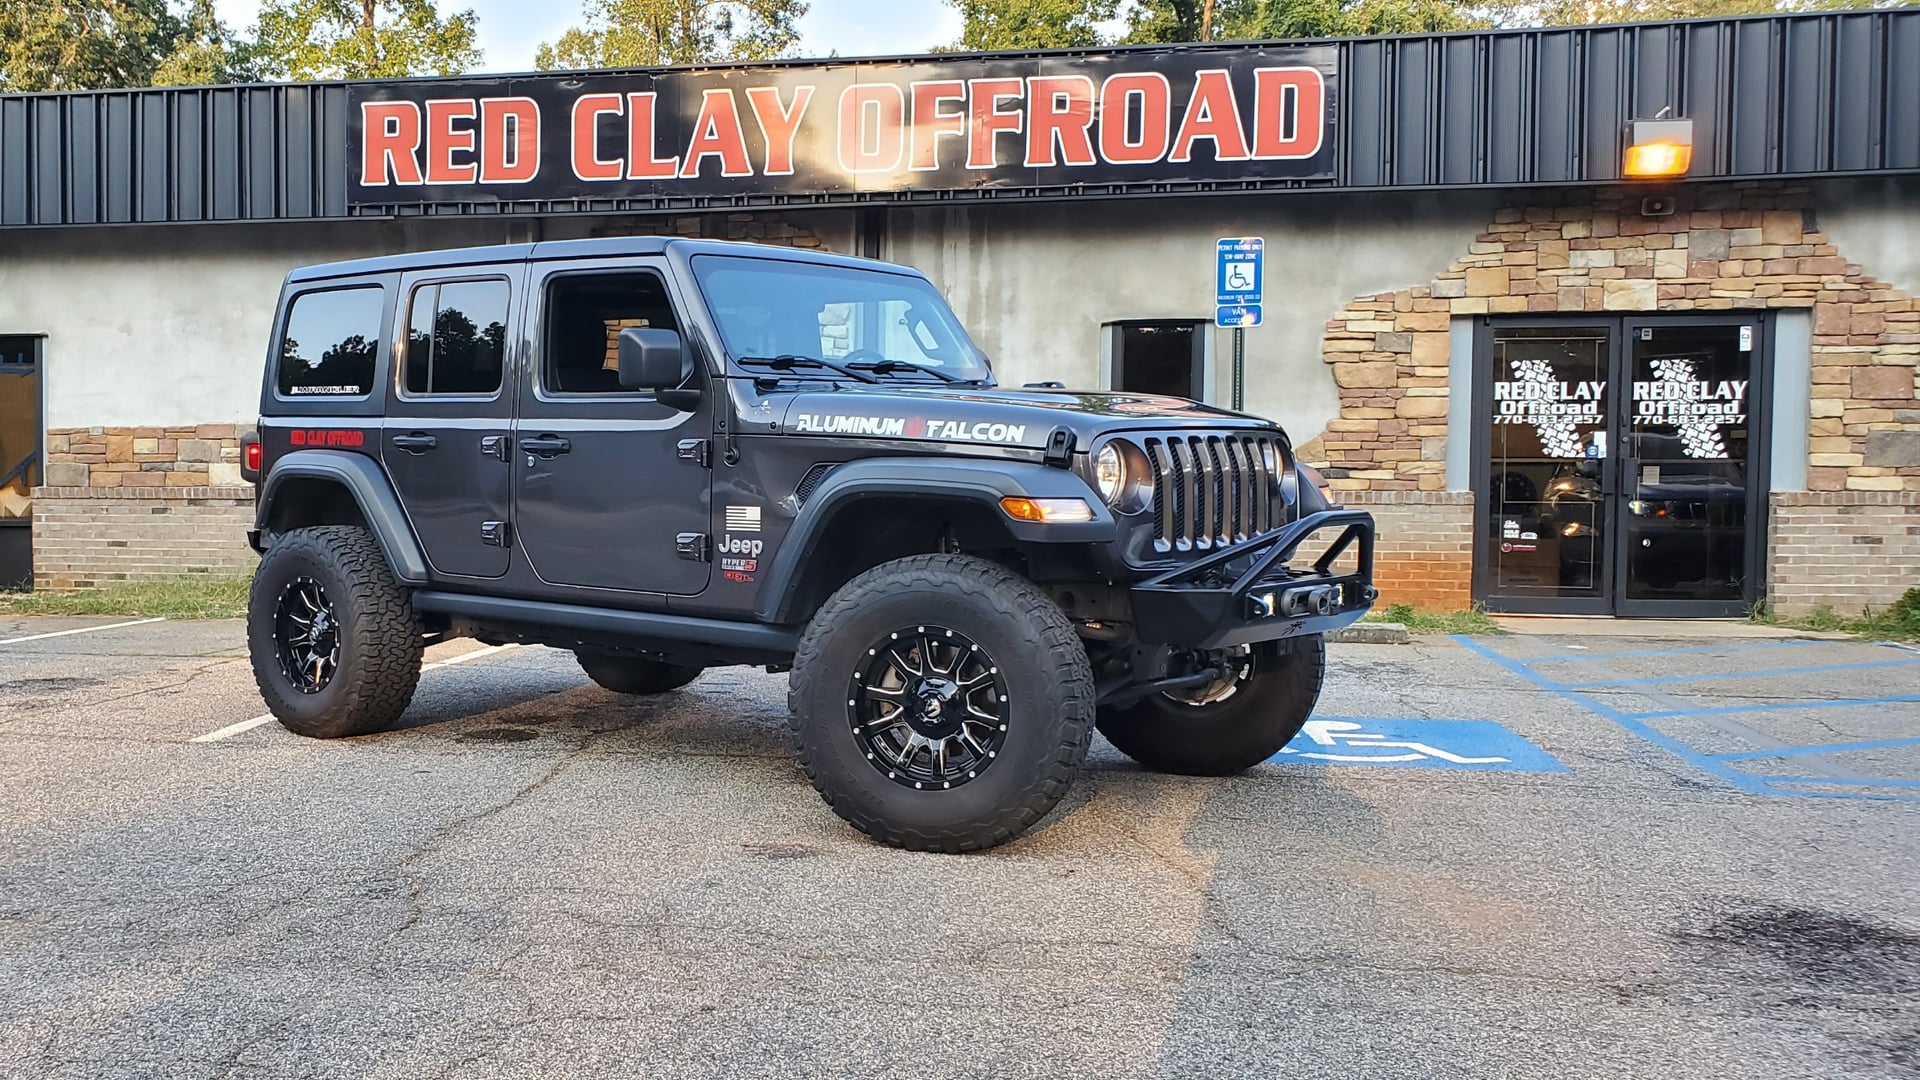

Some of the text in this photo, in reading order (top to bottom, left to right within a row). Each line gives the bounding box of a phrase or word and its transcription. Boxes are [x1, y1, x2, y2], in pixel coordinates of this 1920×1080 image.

[360, 66, 1326, 188] RED CLAY OFFROAD
[1494, 381, 1607, 400] RED CLAY
[1633, 381, 1748, 400] RED CLAY
[1500, 400, 1598, 414] Offroad
[1639, 400, 1739, 414] Offroad
[796, 414, 1026, 442] ALUMINUM FALCON
[1492, 415, 1604, 424] 770-683-2257
[1632, 415, 1746, 424] 770-683-2257
[718, 534, 763, 557] Jeep
